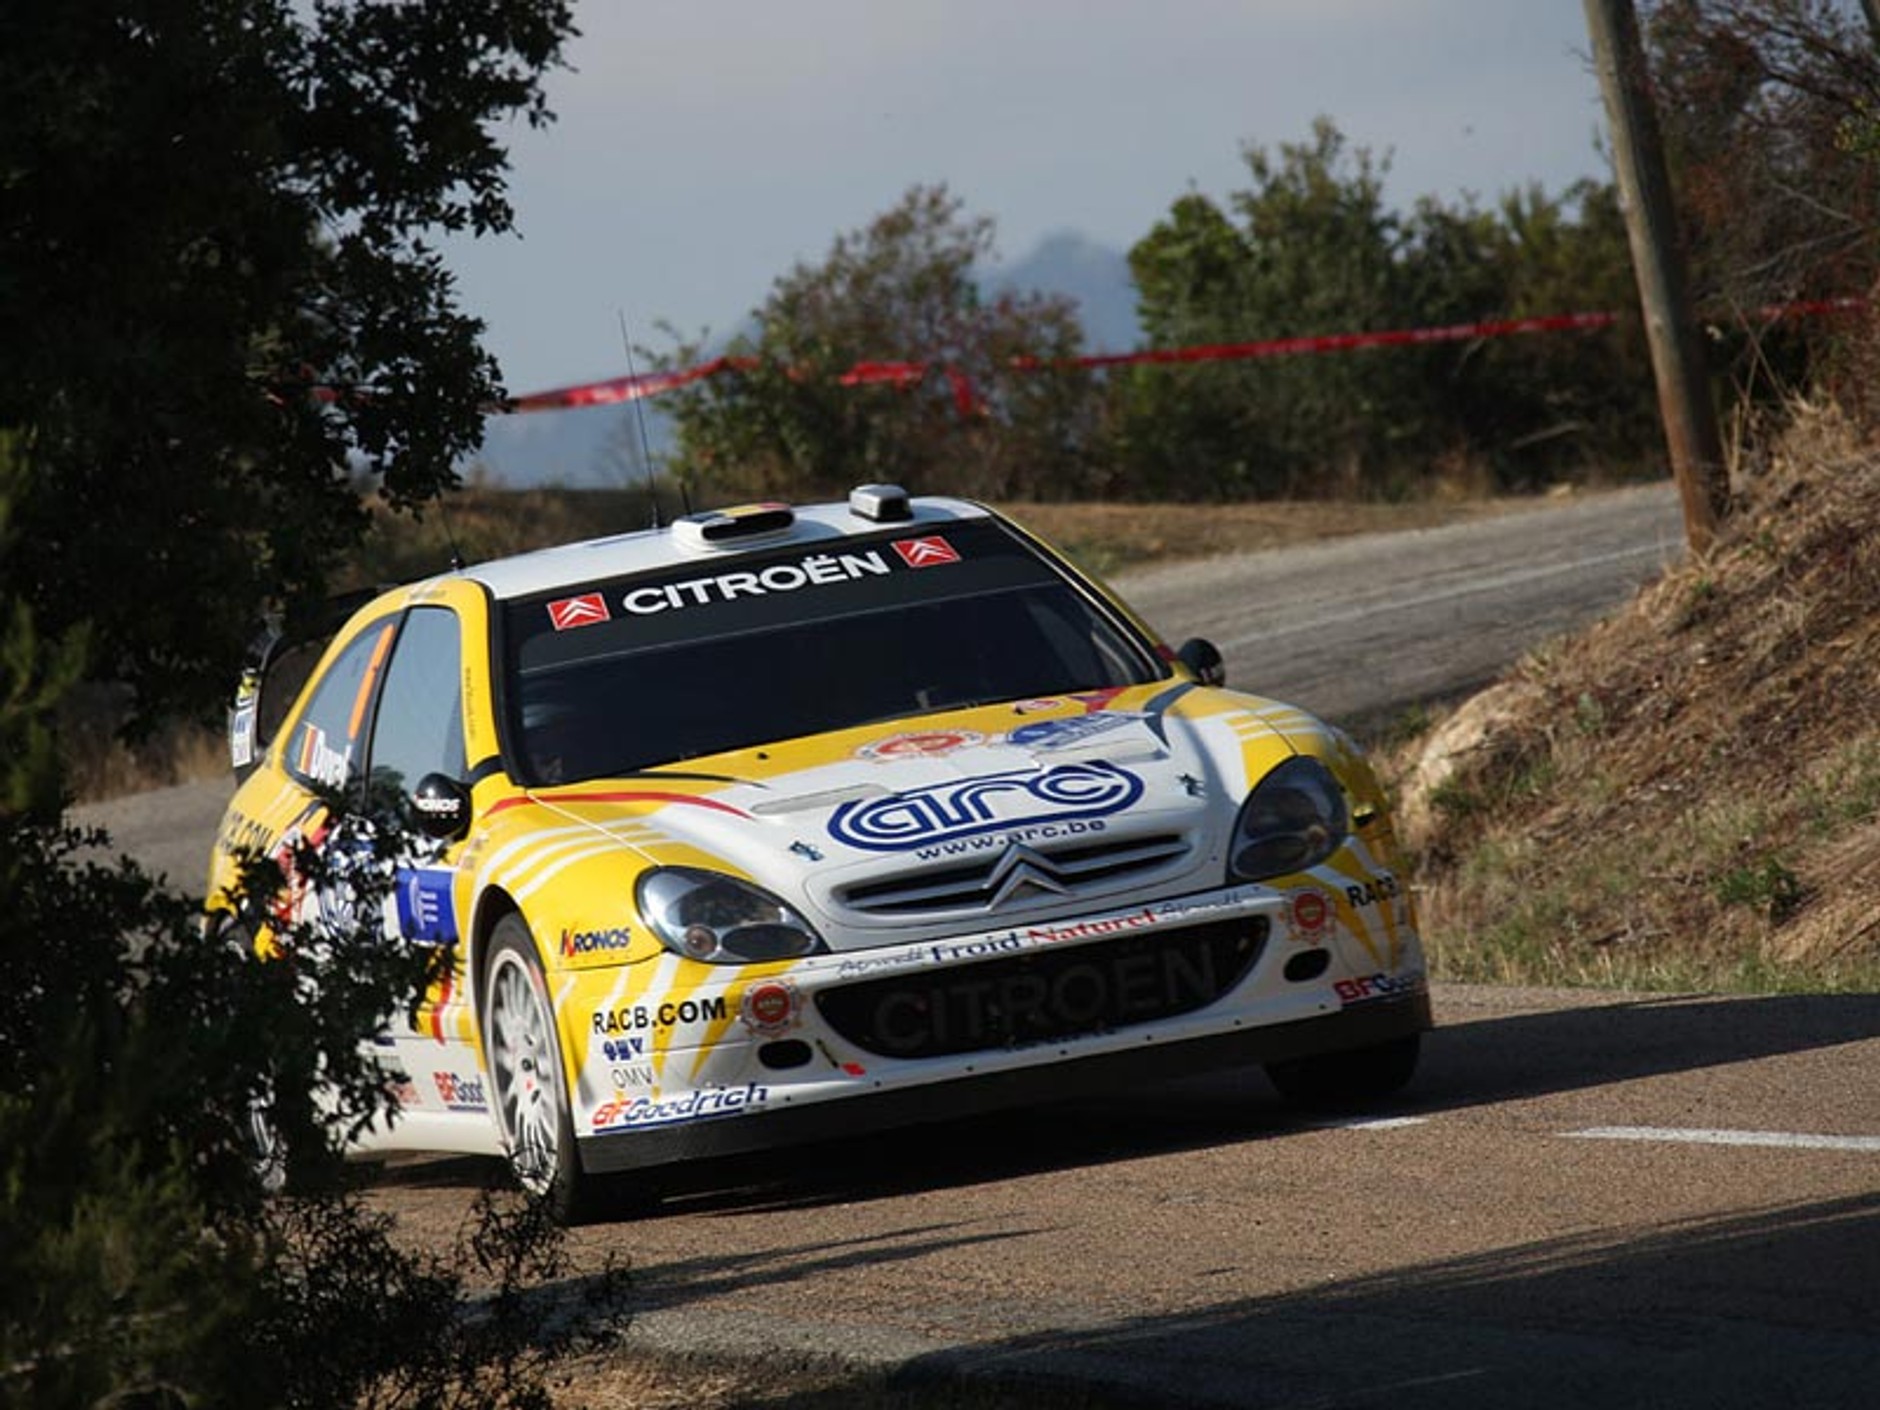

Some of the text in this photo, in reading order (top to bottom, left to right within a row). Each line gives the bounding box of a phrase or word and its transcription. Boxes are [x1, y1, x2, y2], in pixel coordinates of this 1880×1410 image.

[622, 551, 890, 615] CITROËN
[827, 758, 1145, 853] arc
[915, 817, 1107, 862] www.arc.be
[559, 924, 632, 957] KRONOS
[931, 932, 1022, 962] Froid
[592, 996, 728, 1036] RACB.COM
[611, 1066, 653, 1089] OMV
[591, 1081, 769, 1126] BFGoodrich
